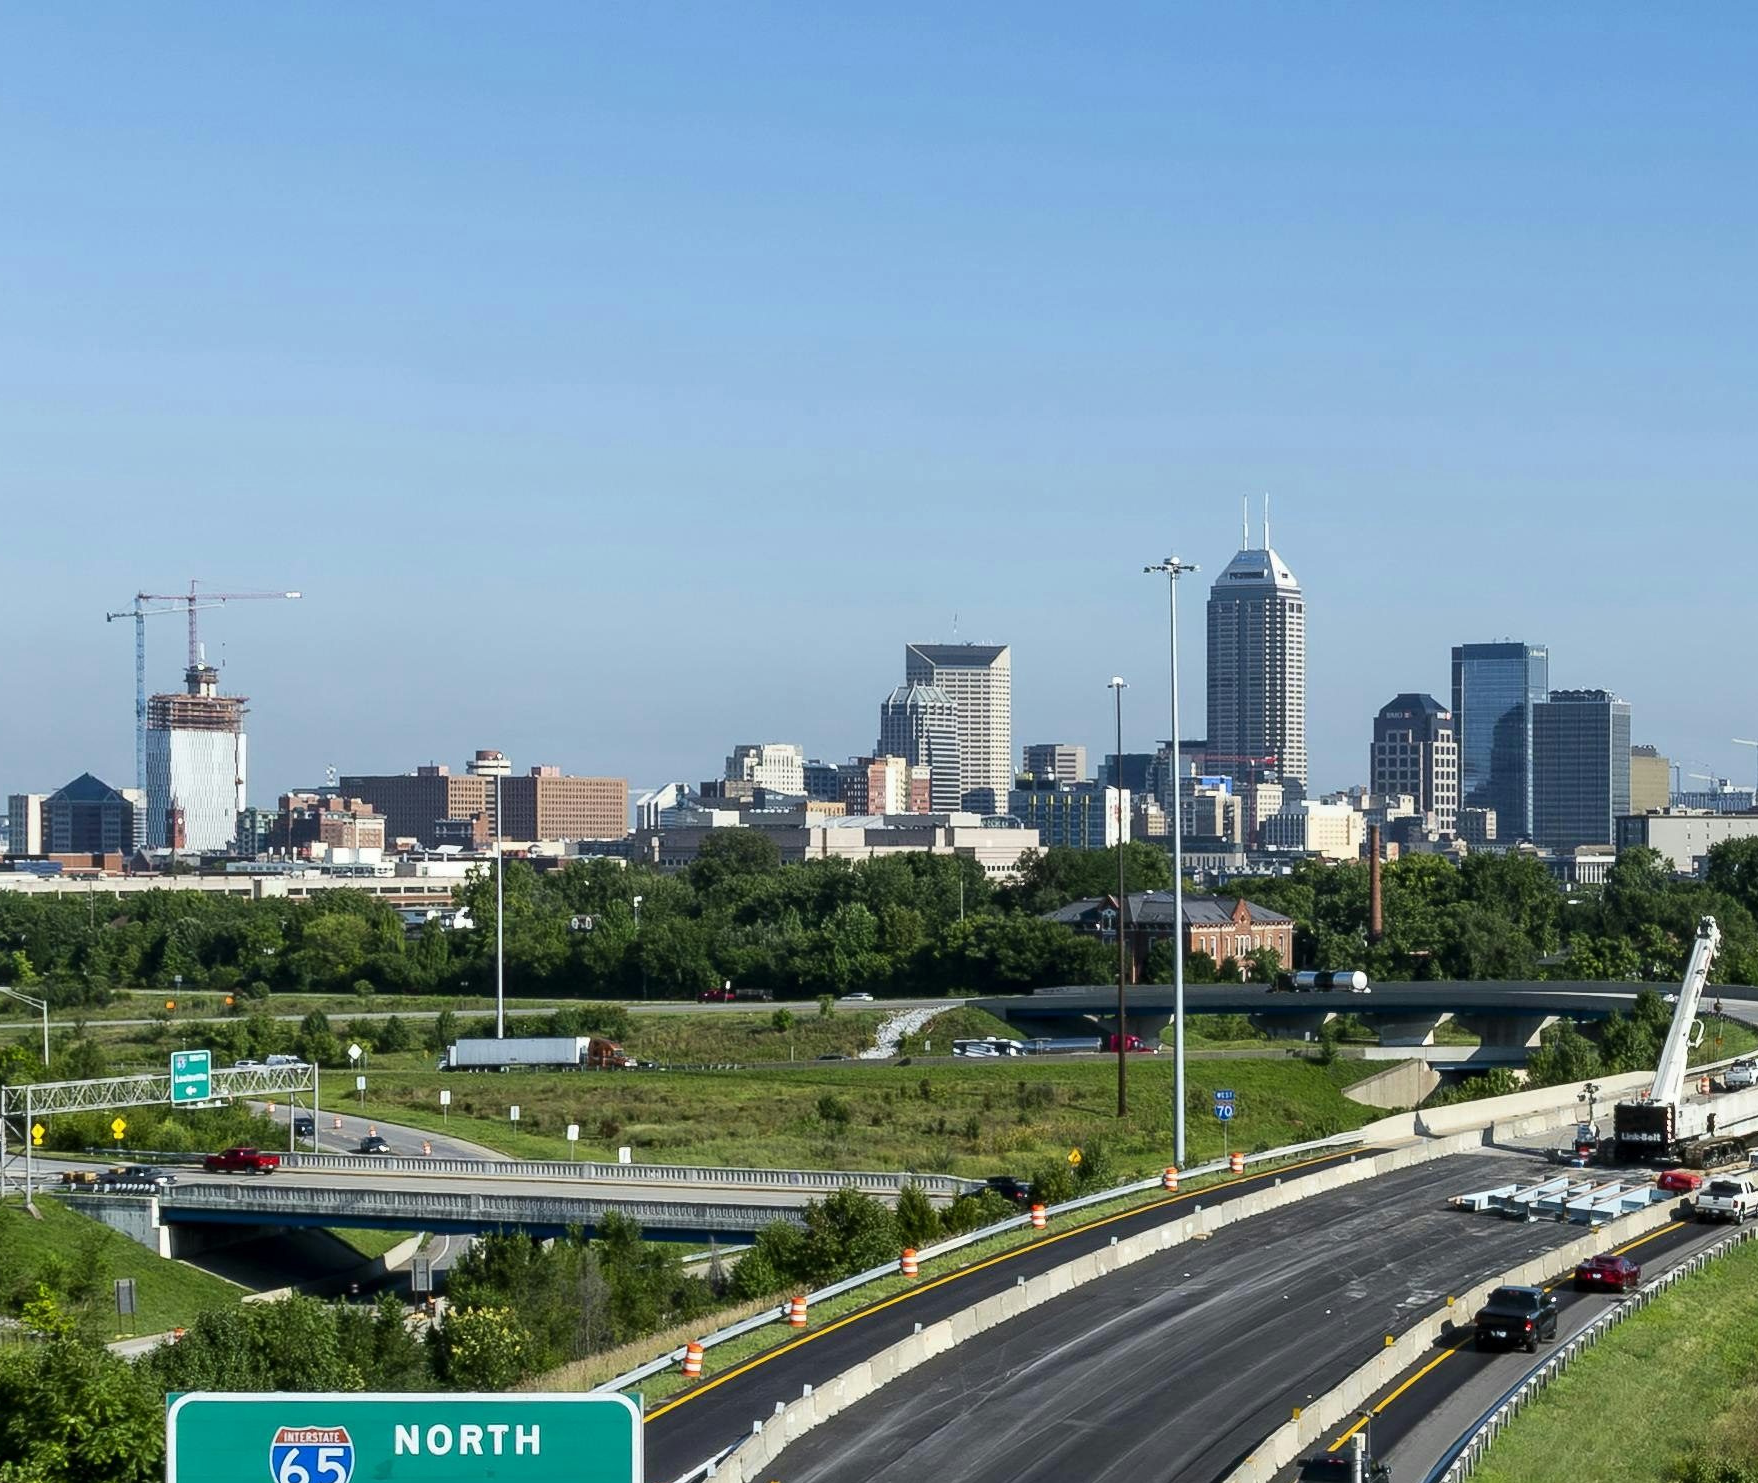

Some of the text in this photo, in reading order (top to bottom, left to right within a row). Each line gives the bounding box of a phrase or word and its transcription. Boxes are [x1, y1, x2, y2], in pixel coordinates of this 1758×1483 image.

[1217, 1105, 1233, 1118] 70
[1621, 1132, 1661, 1142] Link-Belt
[284, 1432, 340, 1443] INTERSTATE
[395, 1424, 540, 1456] NORTH
